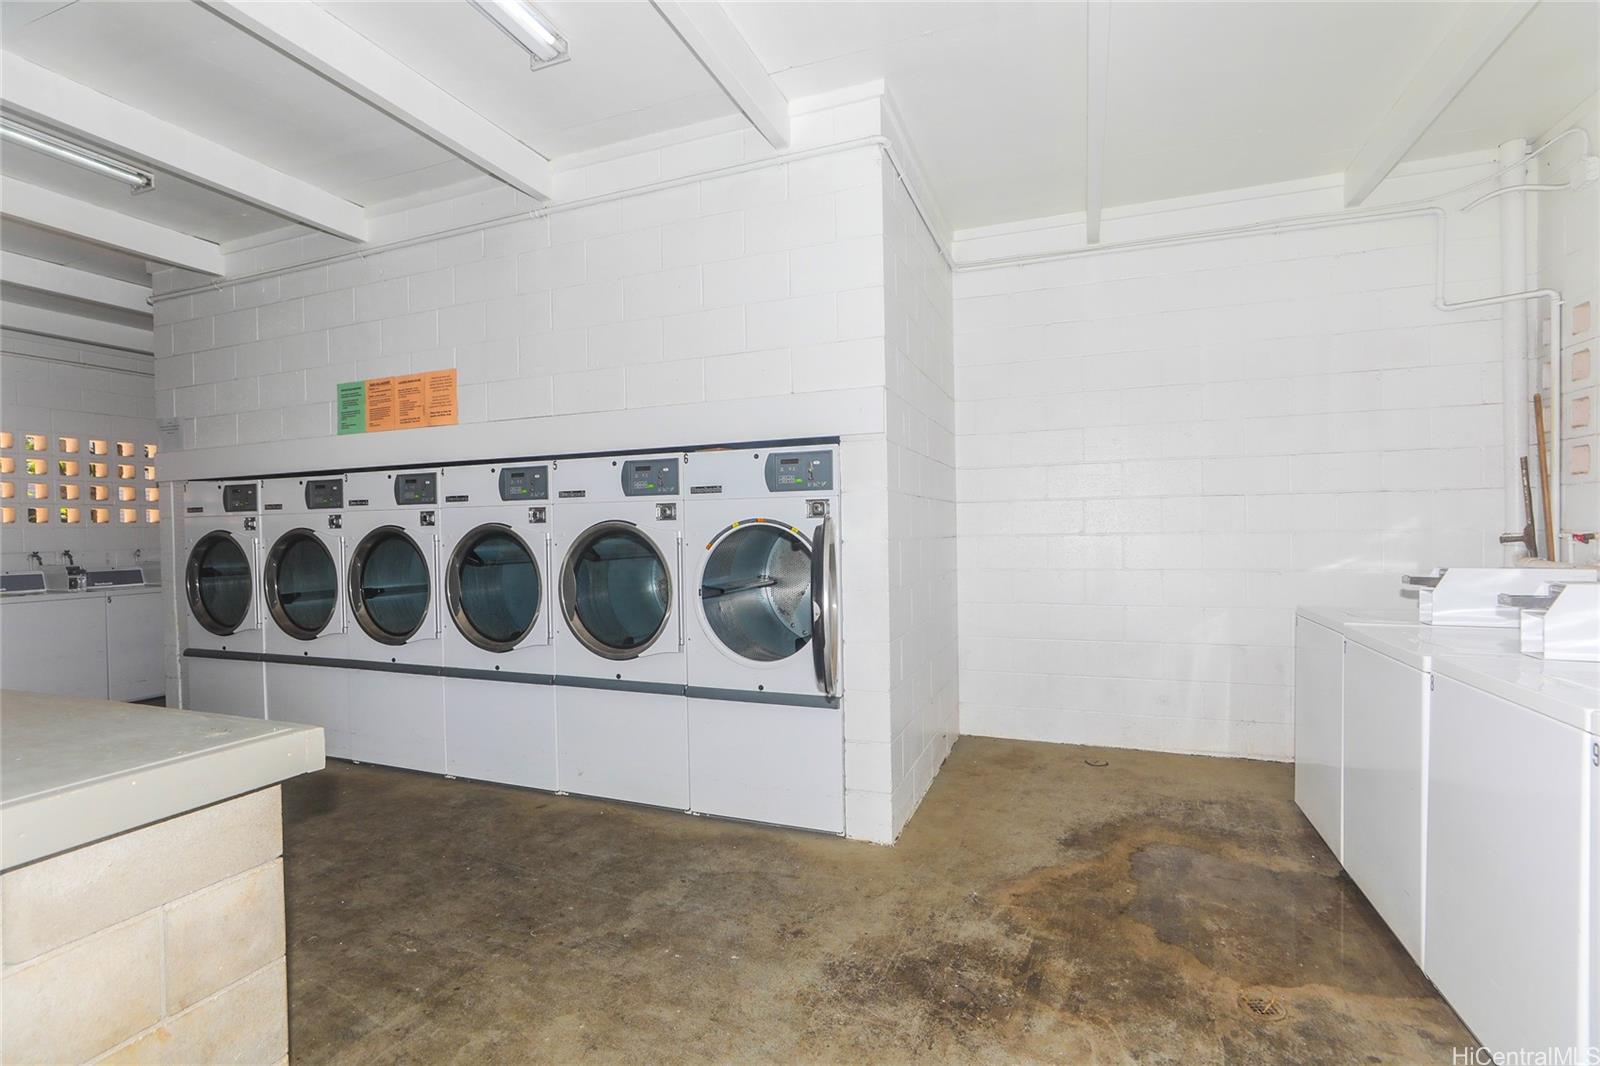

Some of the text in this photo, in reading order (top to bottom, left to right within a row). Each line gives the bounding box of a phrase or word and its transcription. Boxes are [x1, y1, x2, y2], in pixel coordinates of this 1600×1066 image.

[684, 453, 688, 464] 6
[552, 461, 557, 470] 5
[1592, 742, 1600, 767] 9
